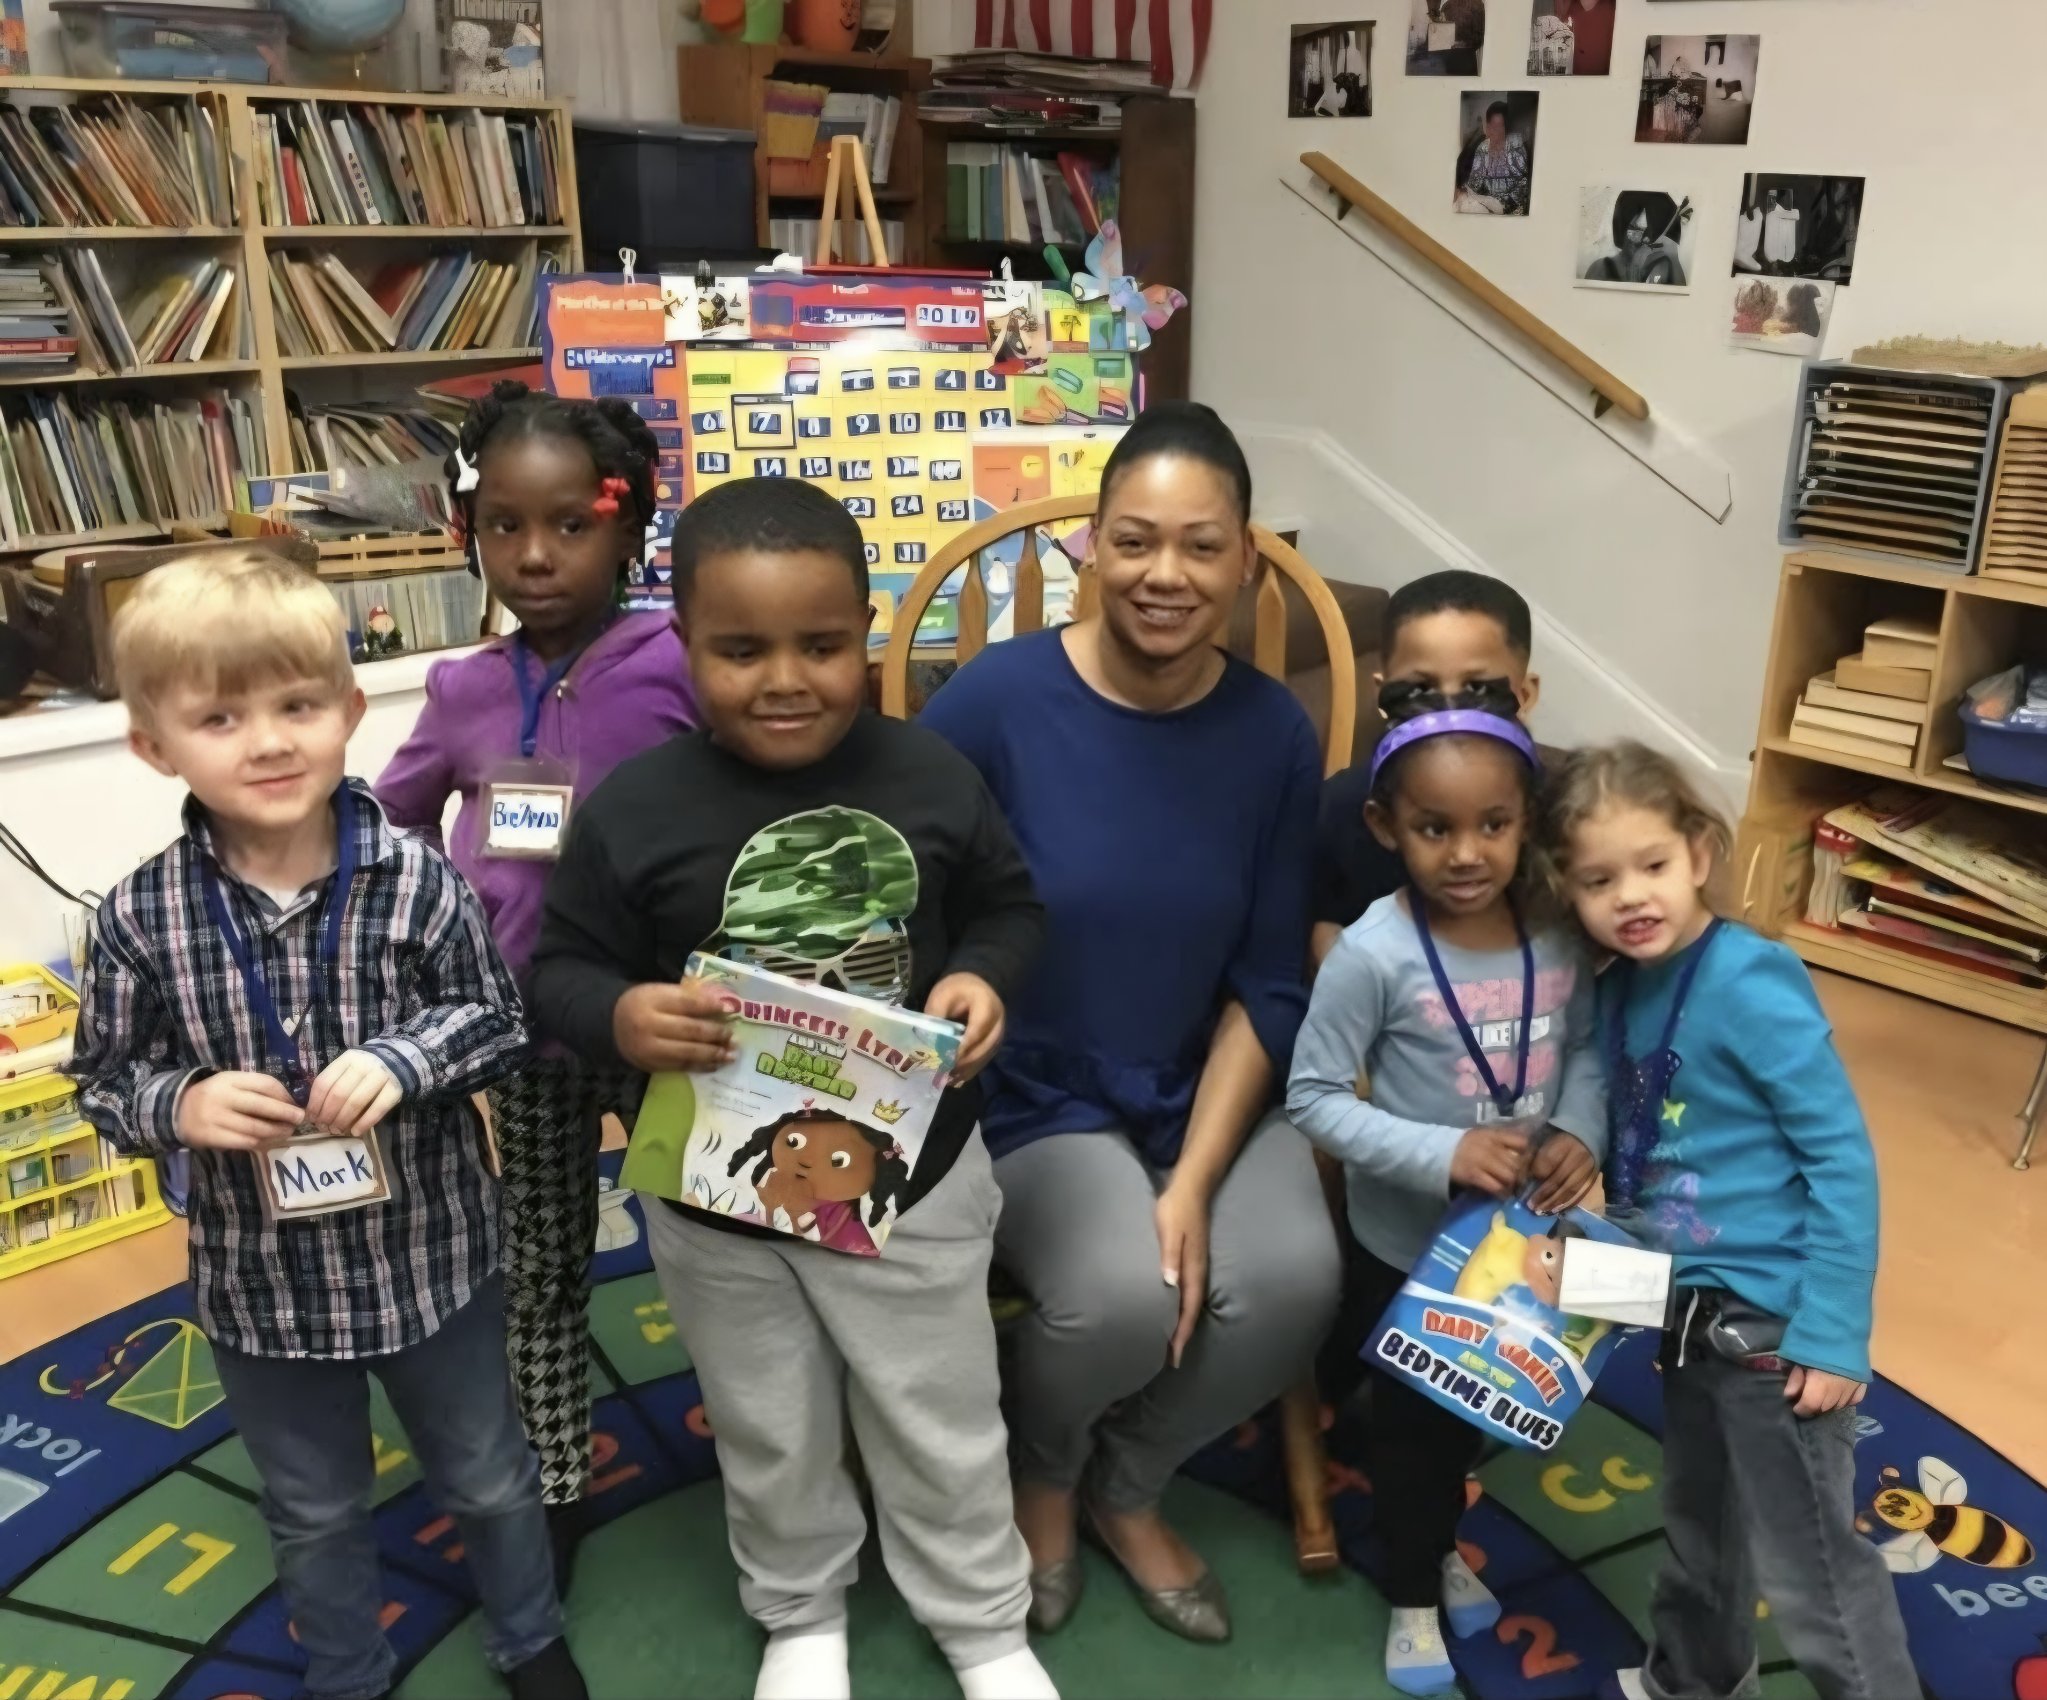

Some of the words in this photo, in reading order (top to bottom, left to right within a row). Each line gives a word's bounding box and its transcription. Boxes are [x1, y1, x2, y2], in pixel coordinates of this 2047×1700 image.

[752, 412, 773, 432] 7
[855, 414, 870, 433] 9
[895, 413, 917, 433] 10
[942, 412, 962, 431] 11
[274, 1150, 373, 1199] Mark
[1381, 1331, 1492, 1411] BEDTIME
[1488, 1395, 1561, 1448] BLUES
[1495, 1613, 1584, 1681] 2
